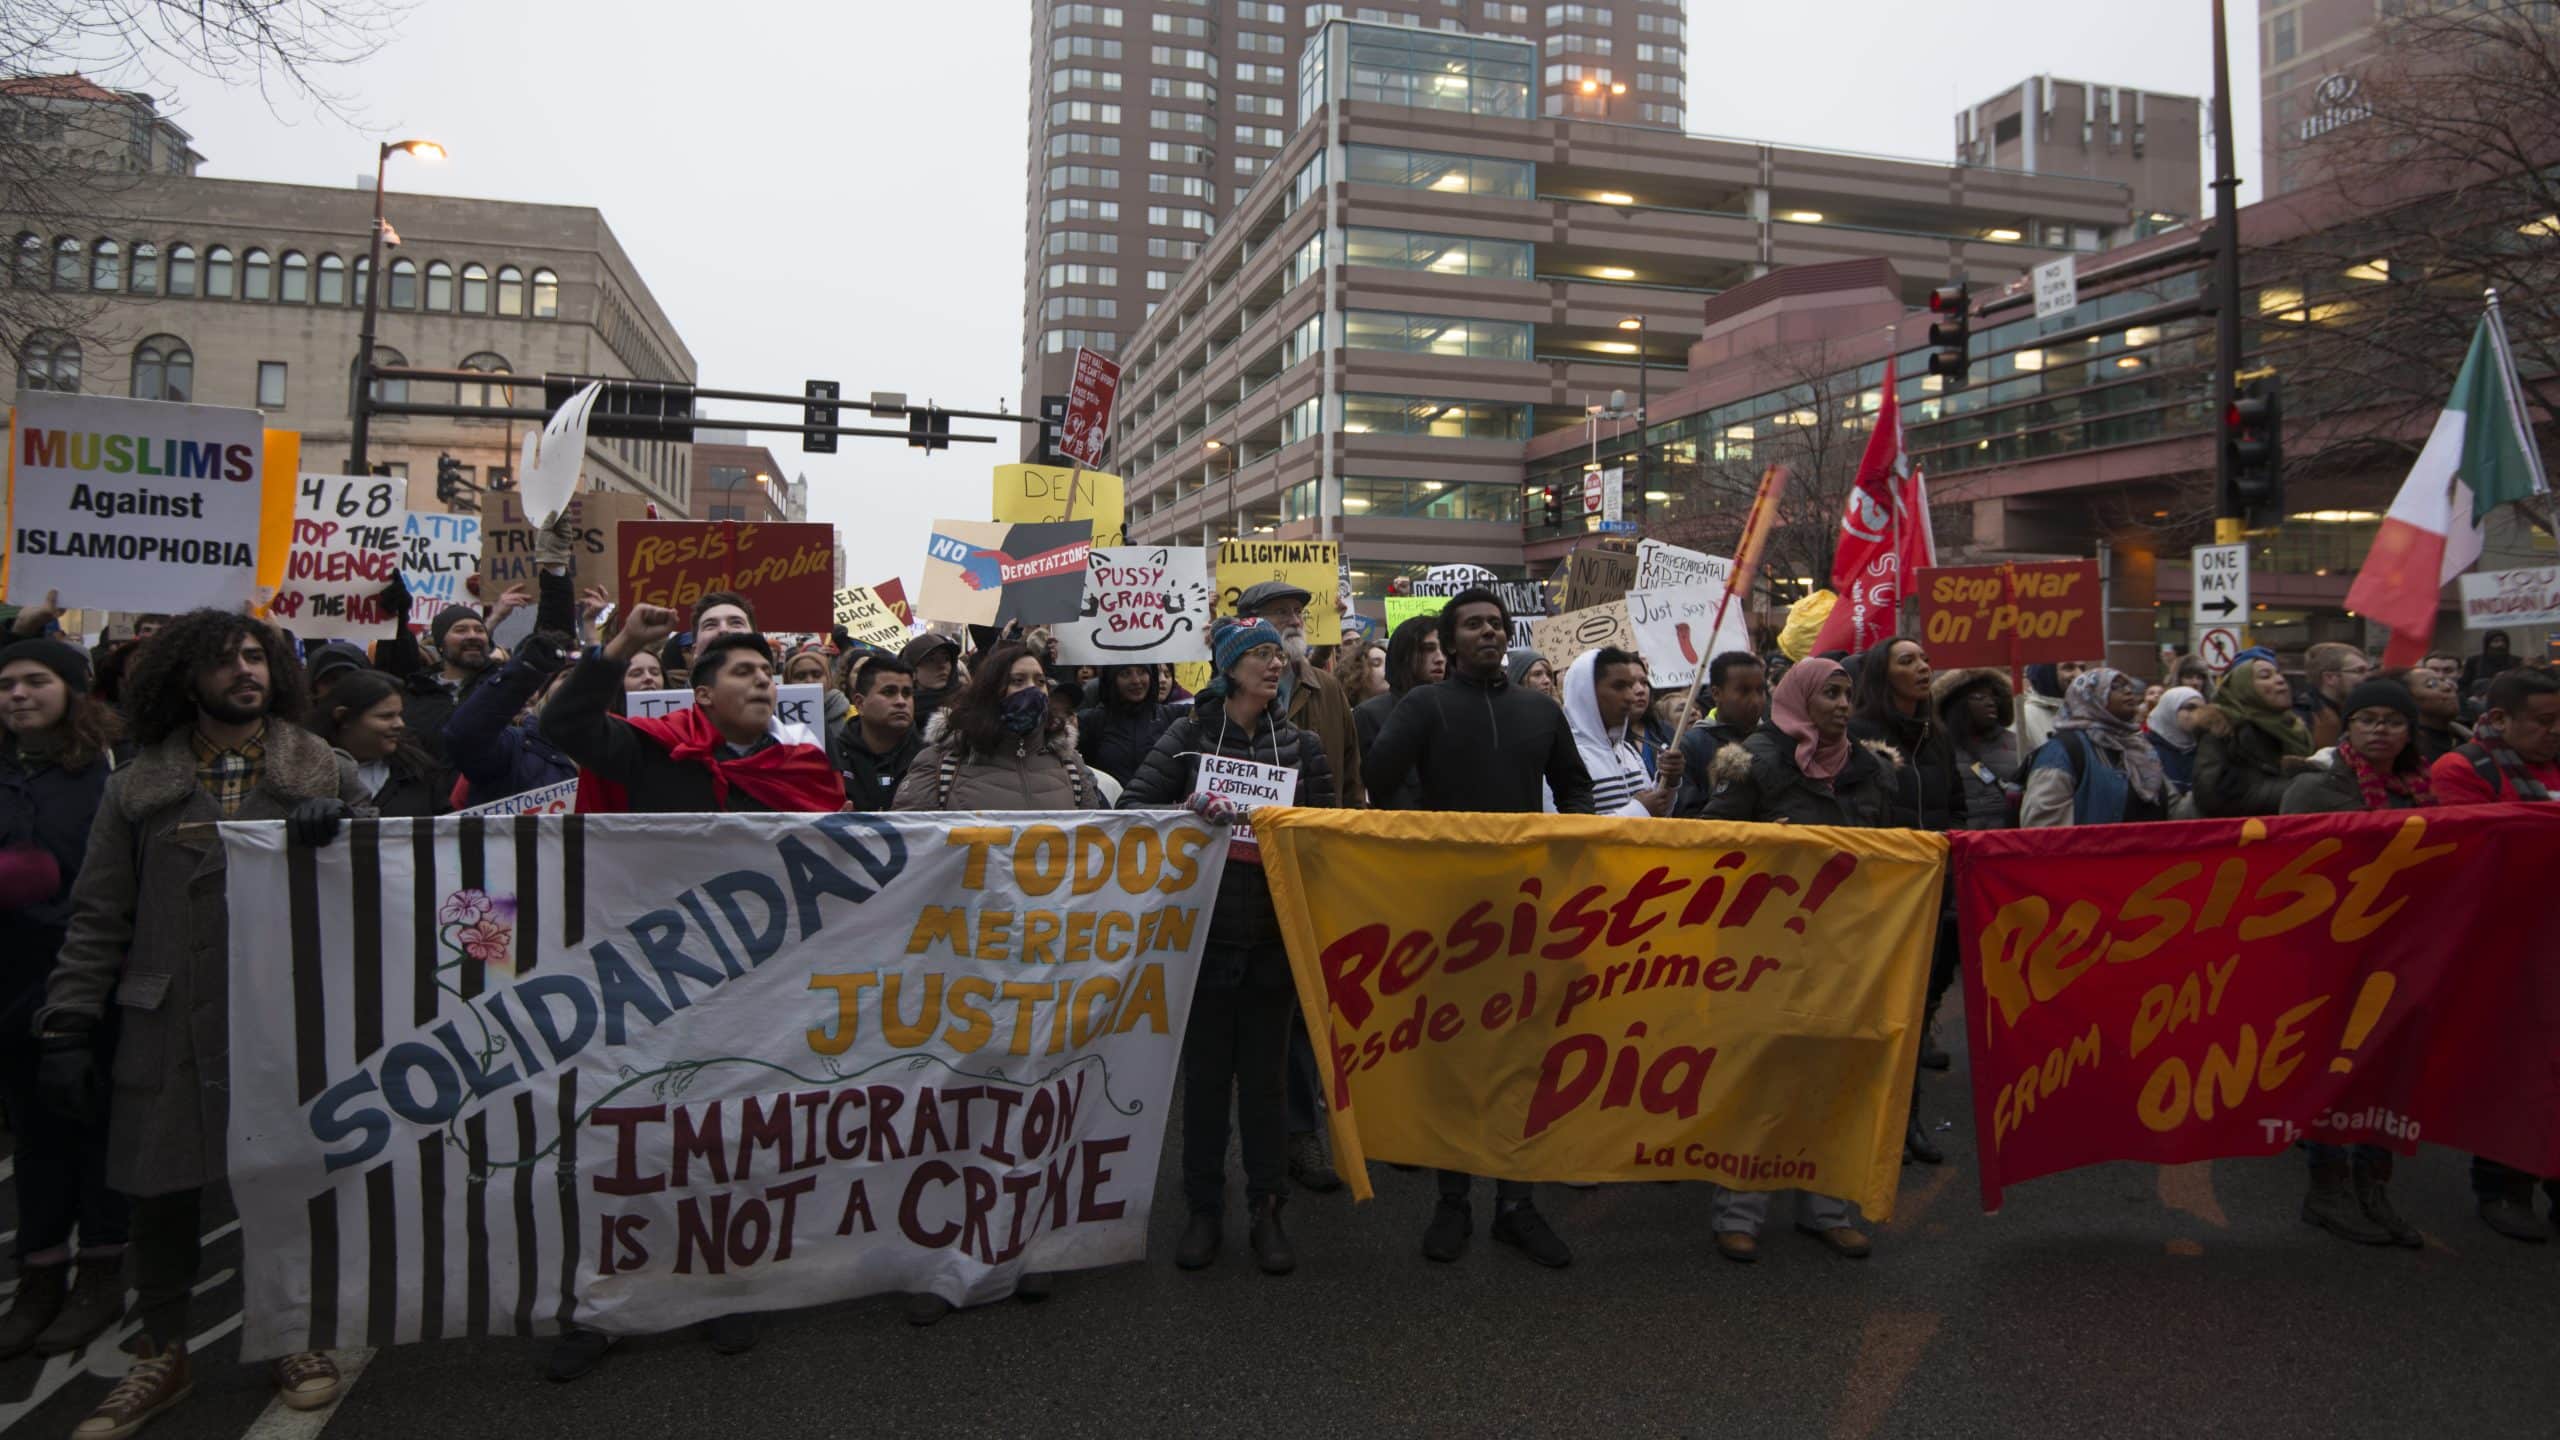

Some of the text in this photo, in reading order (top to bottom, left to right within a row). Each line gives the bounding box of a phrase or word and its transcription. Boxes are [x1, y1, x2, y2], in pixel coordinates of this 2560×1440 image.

[2301, 101, 2373, 139] Hilton
[2042, 280, 2066, 294] TURN
[2045, 266, 2060, 277] NO
[2039, 293, 2072, 312] ON RED
[23, 427, 254, 483] MUSLIMS
[69, 483, 204, 519] Against
[1024, 470, 1094, 507] DEN
[17, 528, 254, 567] ISLAMOPHOBIA
[292, 519, 400, 551] TOP THE
[628, 524, 758, 579] Resist
[932, 538, 967, 562] NO
[288, 549, 397, 582] IOLENCE
[401, 551, 481, 573] NALTY
[1000, 545, 1090, 581] DEPORTATIONS
[1221, 543, 1336, 565] ILLEGITIMATE!
[1577, 556, 1600, 586] NO
[1641, 545, 1728, 582] TEMPERAMENTAL
[2202, 551, 2238, 569] ONE
[1094, 567, 1164, 588] PUSSY
[1273, 569, 1288, 582] BY
[2201, 574, 2239, 592] WAY
[309, 594, 345, 617] THE
[836, 603, 881, 624] BACK
[1100, 590, 1165, 612] GRABS
[856, 619, 874, 631] THE
[1108, 611, 1164, 633] BACK
[1927, 606, 2084, 644] On Poor
[777, 699, 815, 725] RE
[1205, 758, 1288, 782] RESPETA MI
[511, 780, 578, 816] TOGETHE
[1208, 777, 1278, 801] EXISTENCIA
[944, 823, 1202, 898] TODOS
[906, 904, 1198, 965] MERECEN
[1319, 850, 1857, 1031] Resistir!
[1979, 815, 2458, 1035] Resist
[308, 811, 912, 1173] SOLIDARIDAD
[1479, 971, 1537, 1031] el
[1555, 940, 1782, 1028] primer
[805, 963, 1171, 1058] JUSTICIA
[1993, 954, 2240, 1152] FROM DAY
[589, 1066, 1086, 1198] IMMIGRATION
[2312, 1106, 2421, 1142] Coalitio
[1634, 1141, 1817, 1182] La Coalición
[596, 1134, 1132, 1277] IS NOT A CRIME
